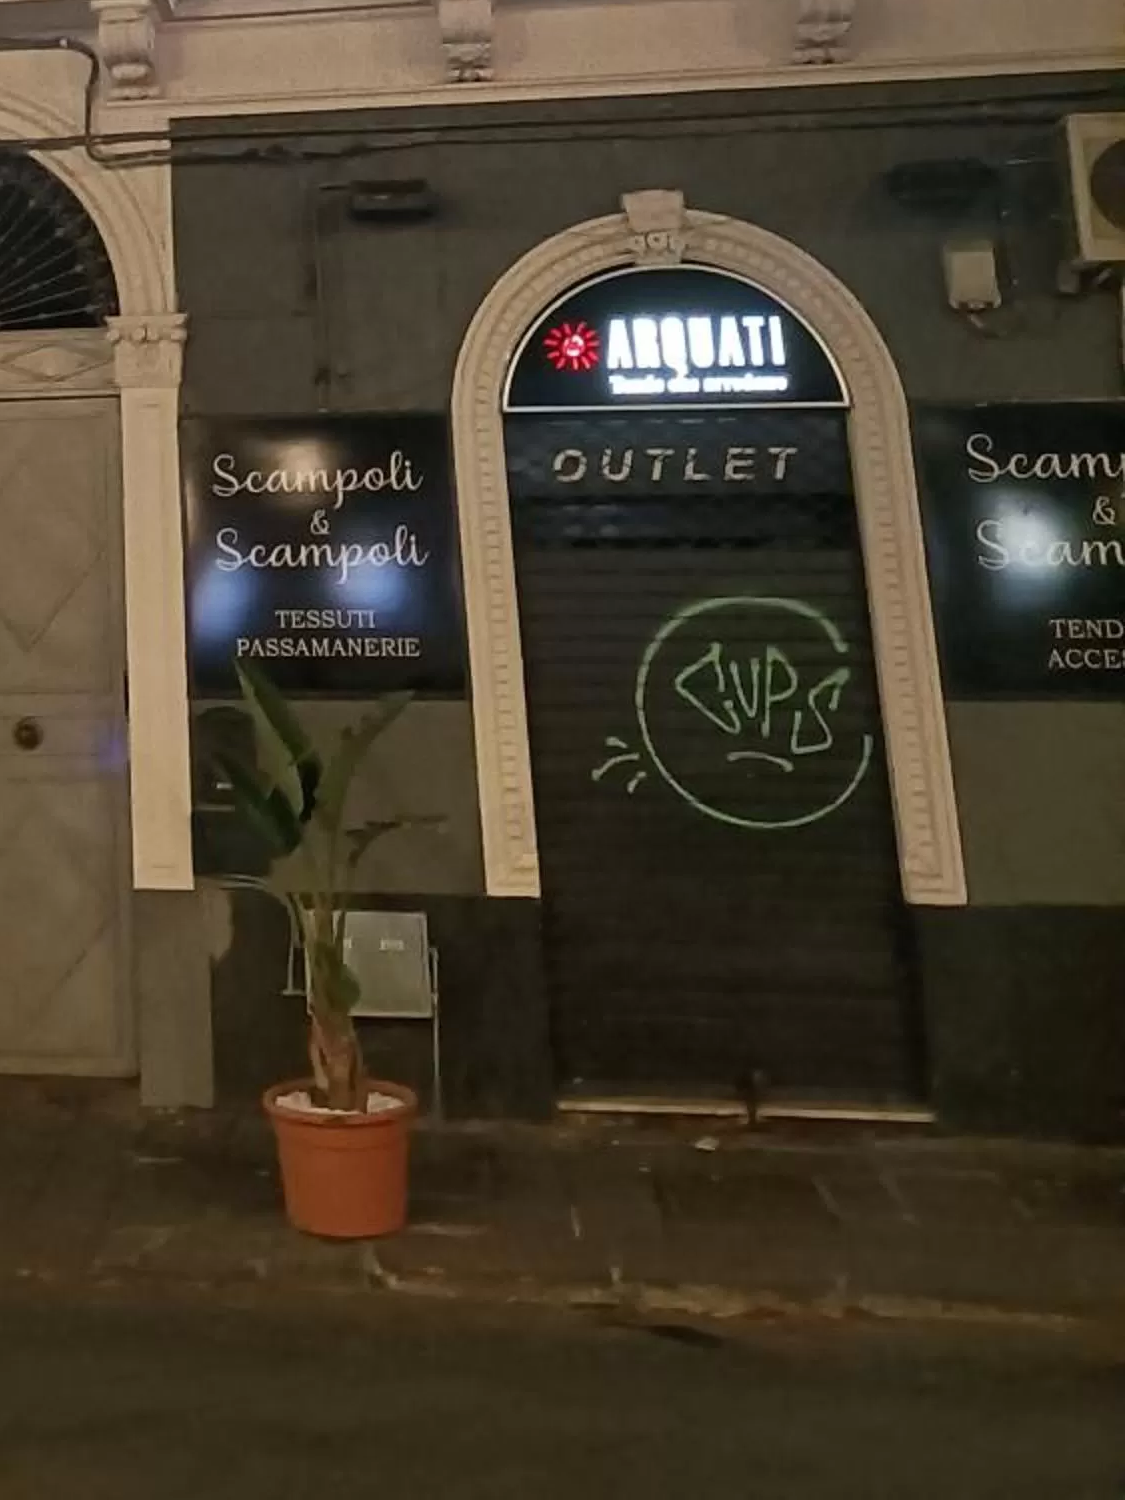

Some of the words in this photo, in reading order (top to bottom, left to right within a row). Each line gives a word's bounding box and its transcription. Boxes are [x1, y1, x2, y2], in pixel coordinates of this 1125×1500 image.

[607, 314, 786, 380] ARQUATI
[212, 450, 424, 509] Scampoli
[552, 447, 798, 483] OUTLET
[966, 433, 1125, 499] Scam
[310, 509, 331, 535] &
[1092, 495, 1116, 525] &
[215, 525, 429, 585] Scampoli
[275, 609, 376, 629] TESSUTI
[237, 638, 421, 657] PASSAMANERIE
[1049, 649, 1125, 669] ACCE
